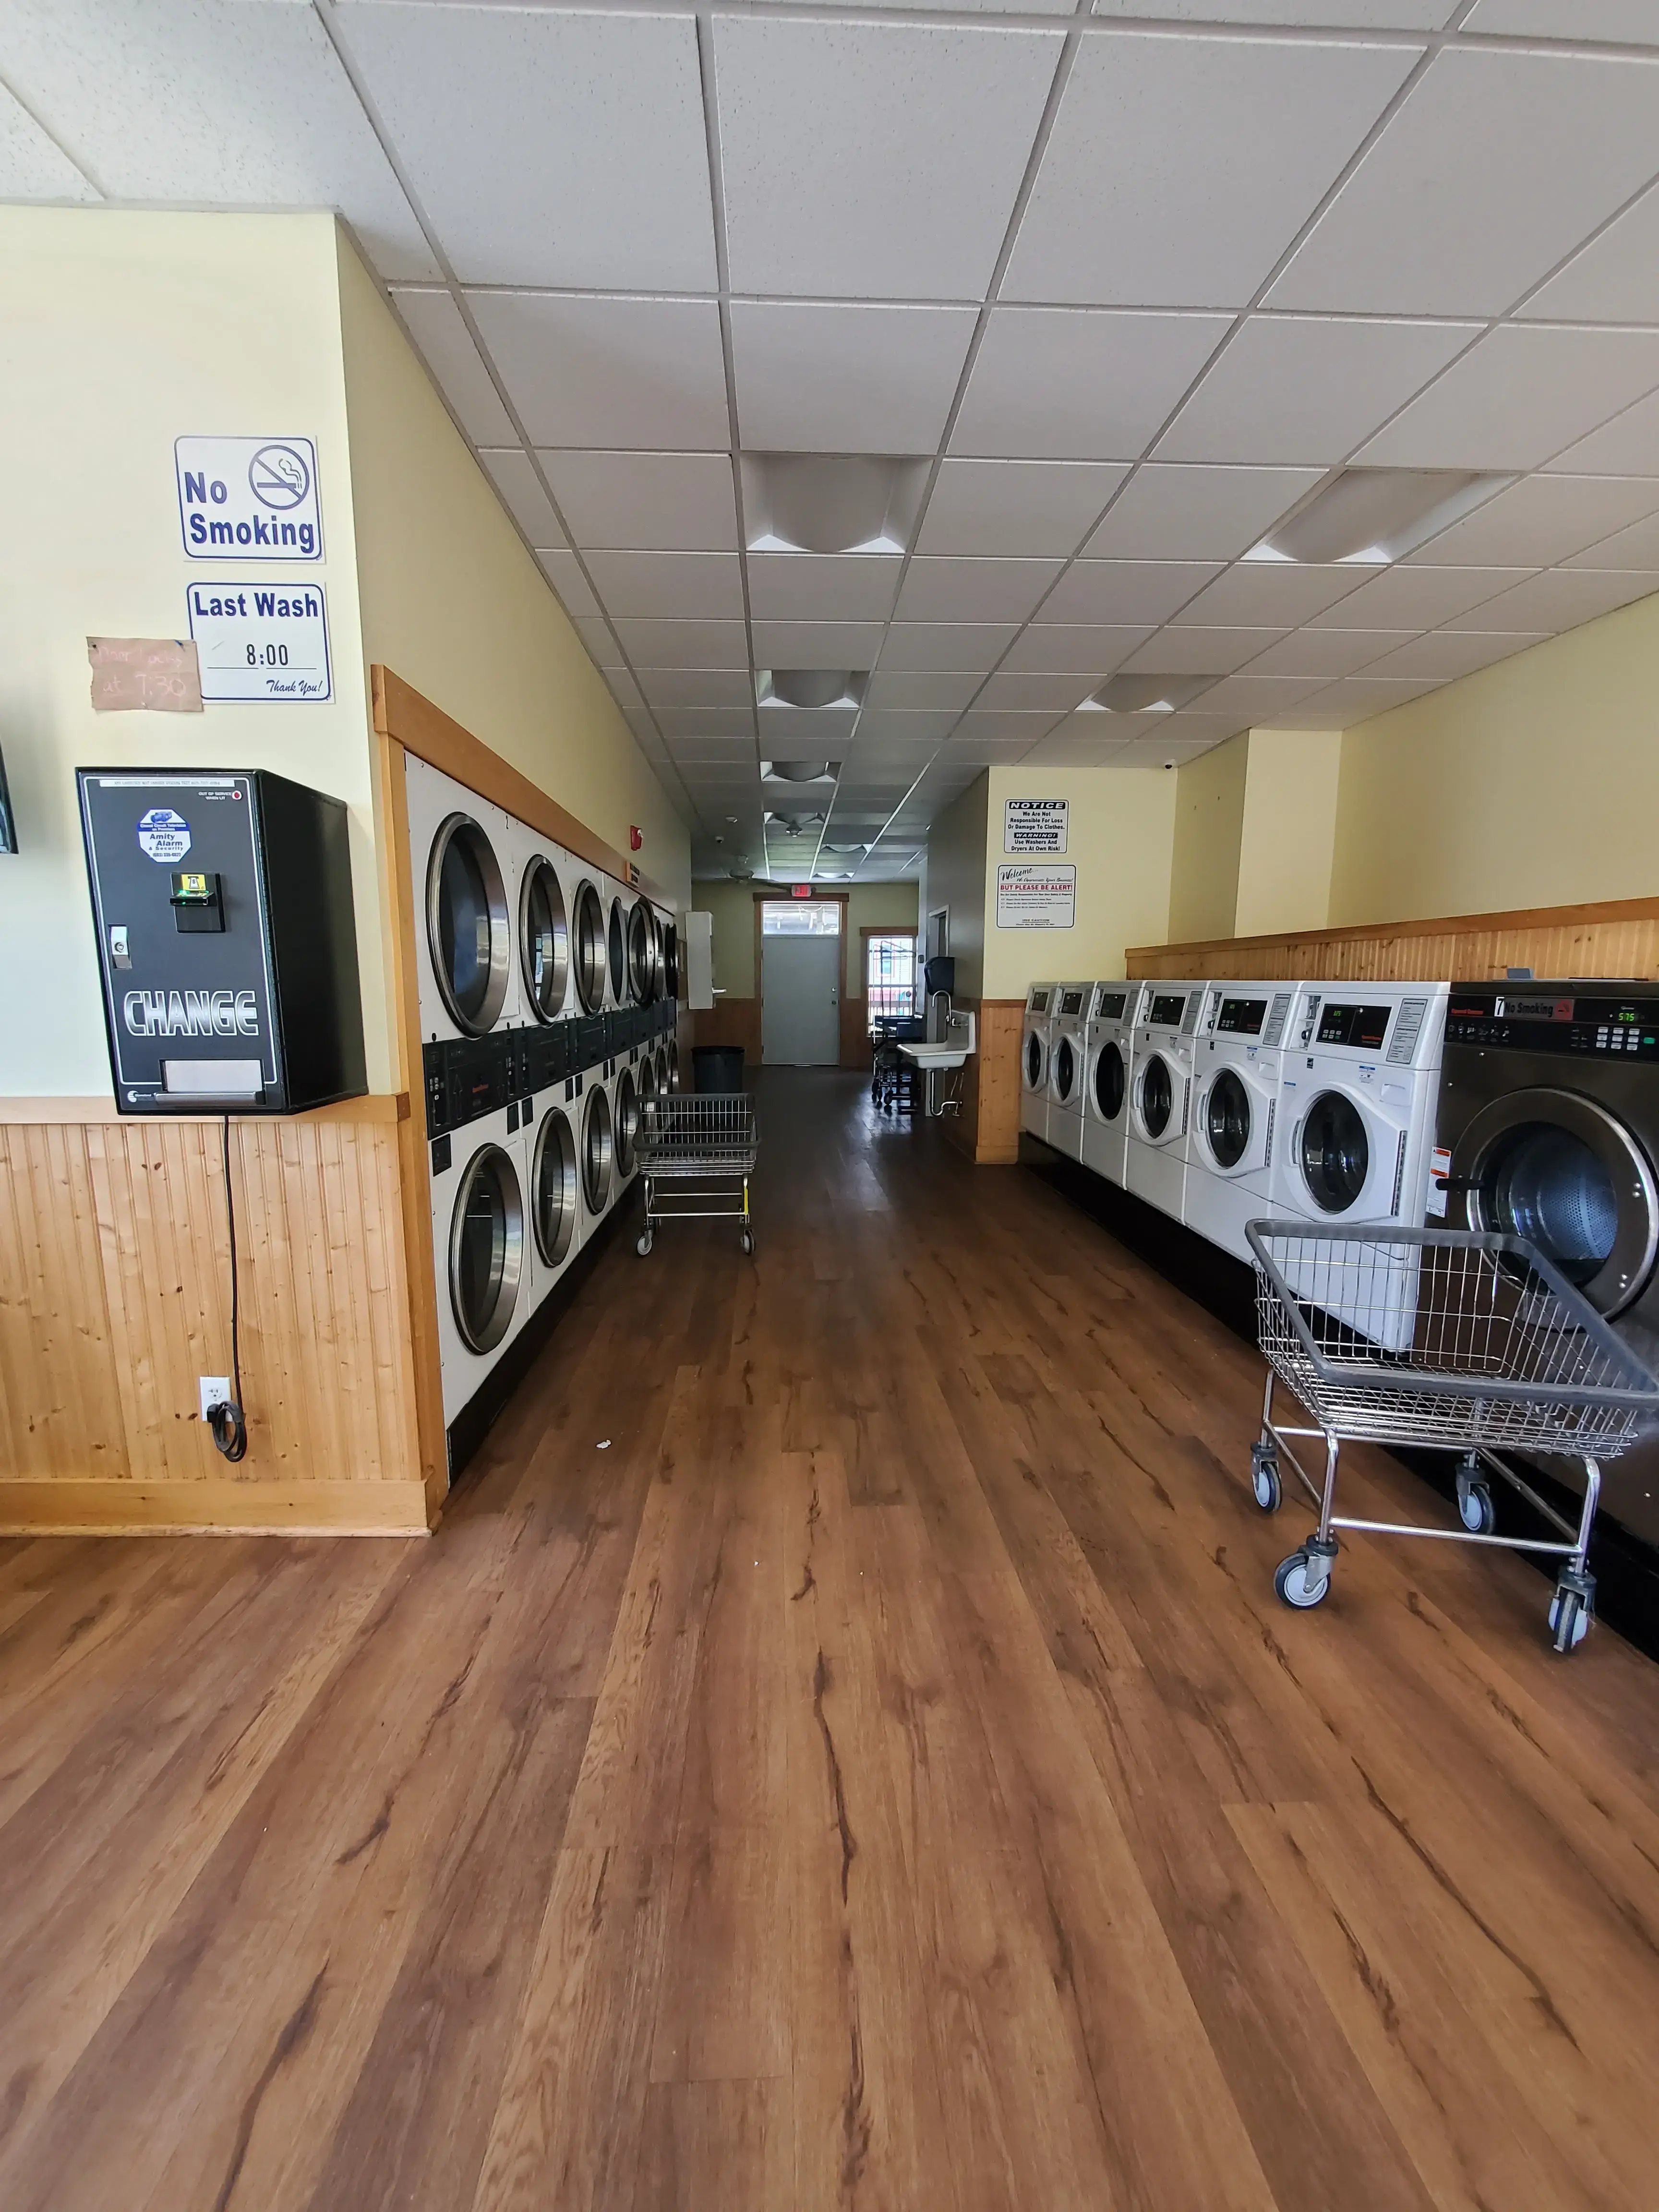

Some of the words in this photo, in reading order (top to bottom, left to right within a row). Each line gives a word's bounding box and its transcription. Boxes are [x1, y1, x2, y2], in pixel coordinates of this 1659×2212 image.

[184, 471, 228, 504] No
[190, 513, 314, 554] Smoking
[194, 591, 248, 617] Last
[253, 592, 318, 617] Wash
[246, 644, 289, 666] 8:00
[103, 673, 121, 693] at
[266, 679, 297, 693] Thank
[298, 680, 323, 696] You!
[123, 990, 259, 1036] CHANGE
[1497, 998, 1505, 1015] 7
[1504, 1002, 1515, 1013] No
[1517, 1002, 1553, 1018] Smoking
